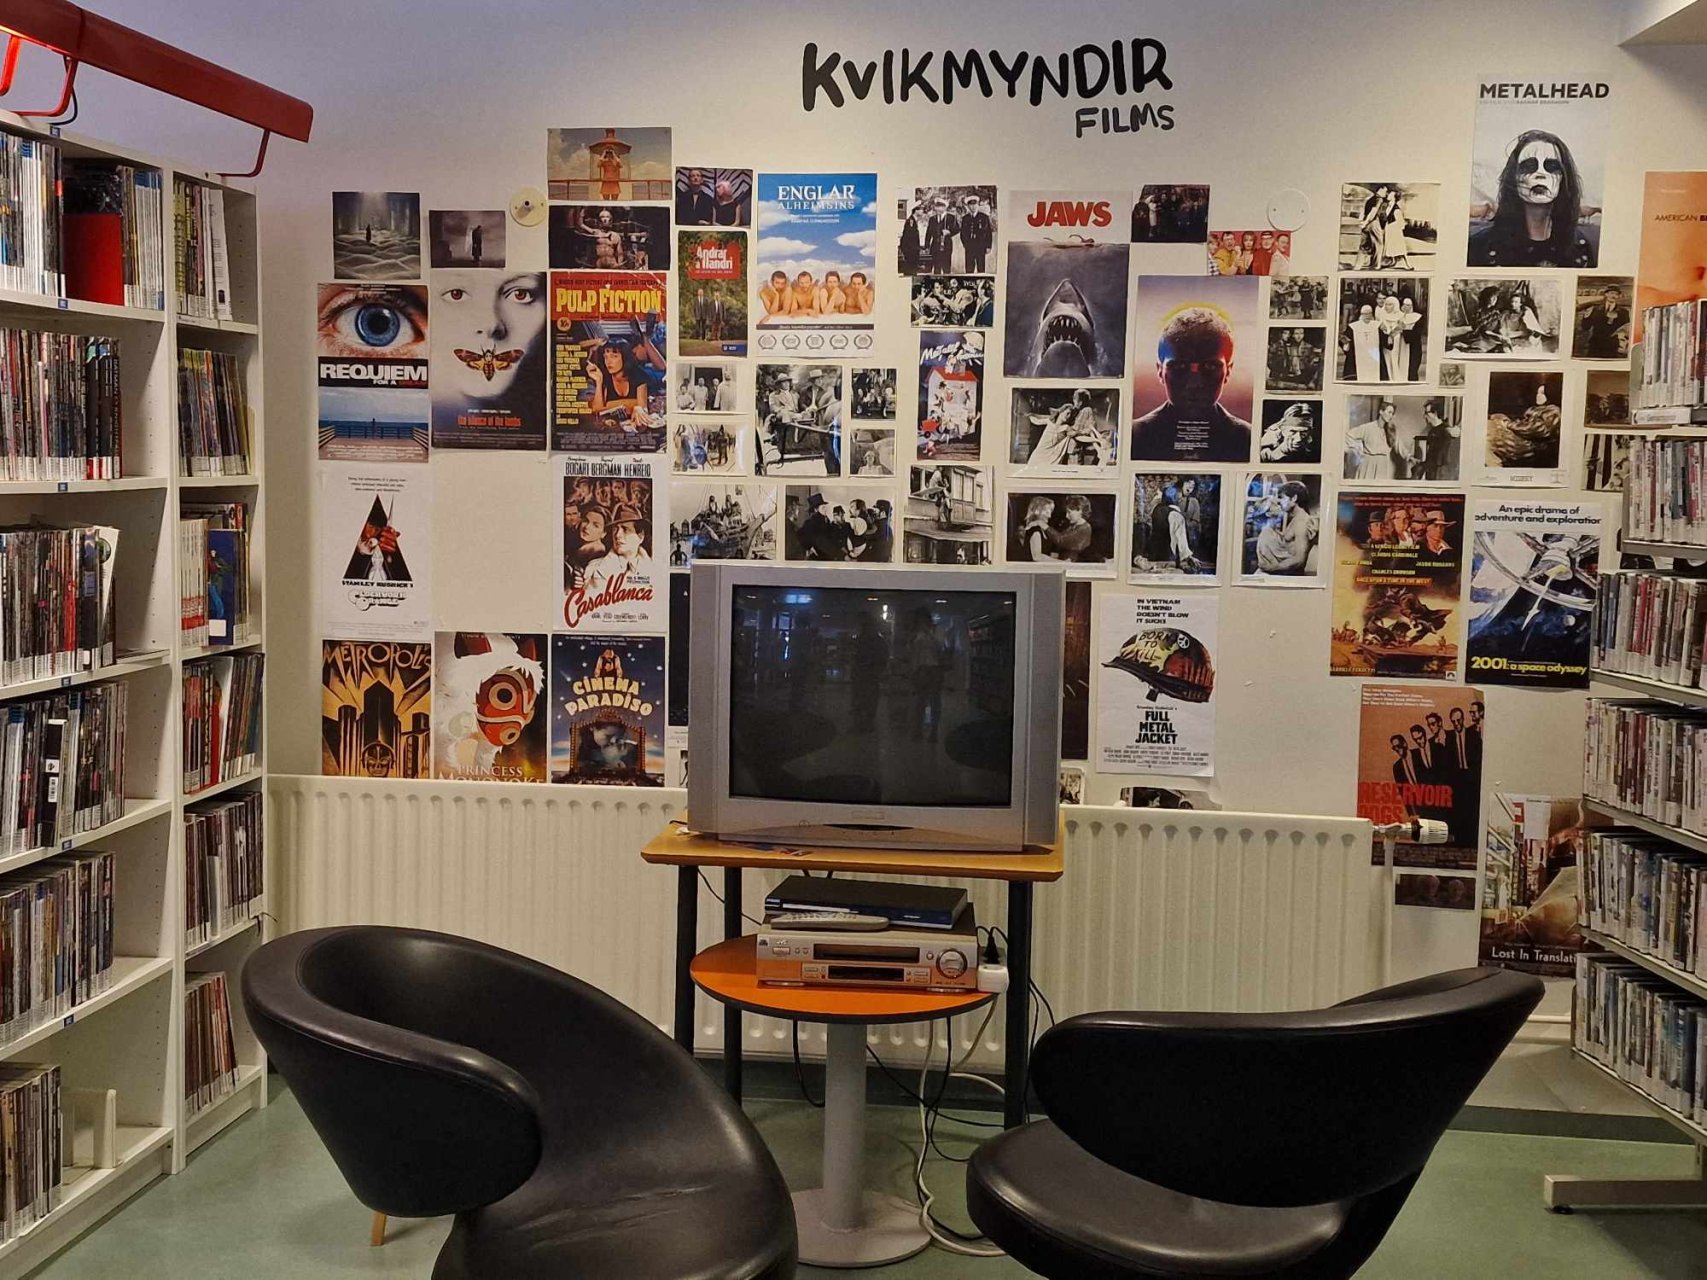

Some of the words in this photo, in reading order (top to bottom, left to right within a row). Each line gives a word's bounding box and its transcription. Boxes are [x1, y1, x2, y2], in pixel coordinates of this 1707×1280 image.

[802, 38, 1173, 111] KVIKMYNDIR
[1480, 83, 1609, 98] METALHEAD
[1075, 103, 1174, 138] FILMS
[778, 185, 855, 200] ENGLAR
[1027, 201, 1113, 228] JAWS
[556, 288, 597, 313] PULP
[599, 288, 661, 314] FICTION
[320, 364, 427, 381] REQUIEM
[591, 462, 621, 476] BERGMAN
[1499, 505, 1513, 513] An
[1514, 505, 1533, 516] epic
[1535, 505, 1568, 514] drama
[1569, 506, 1580, 515] of
[1525, 515, 1545, 523] and
[564, 572, 653, 628] Casablanca
[1144, 641, 1158, 649] TO
[323, 641, 431, 689] METROPOLIS
[1518, 663, 1546, 674] space
[1546, 662, 1588, 675] odyssey
[573, 676, 640, 695] CINEMA
[564, 692, 653, 716] PARADISO
[1145, 711, 1170, 722] FULL
[1139, 722, 1175, 733] METAL
[1135, 733, 1178, 744] JACKET
[457, 765, 523, 777] PRINCESS
[1359, 782, 1453, 808] RESERVOIR
[1492, 946, 1515, 959] Lost
[1520, 948, 1529, 960] In
[1533, 949, 1577, 963] Translati
